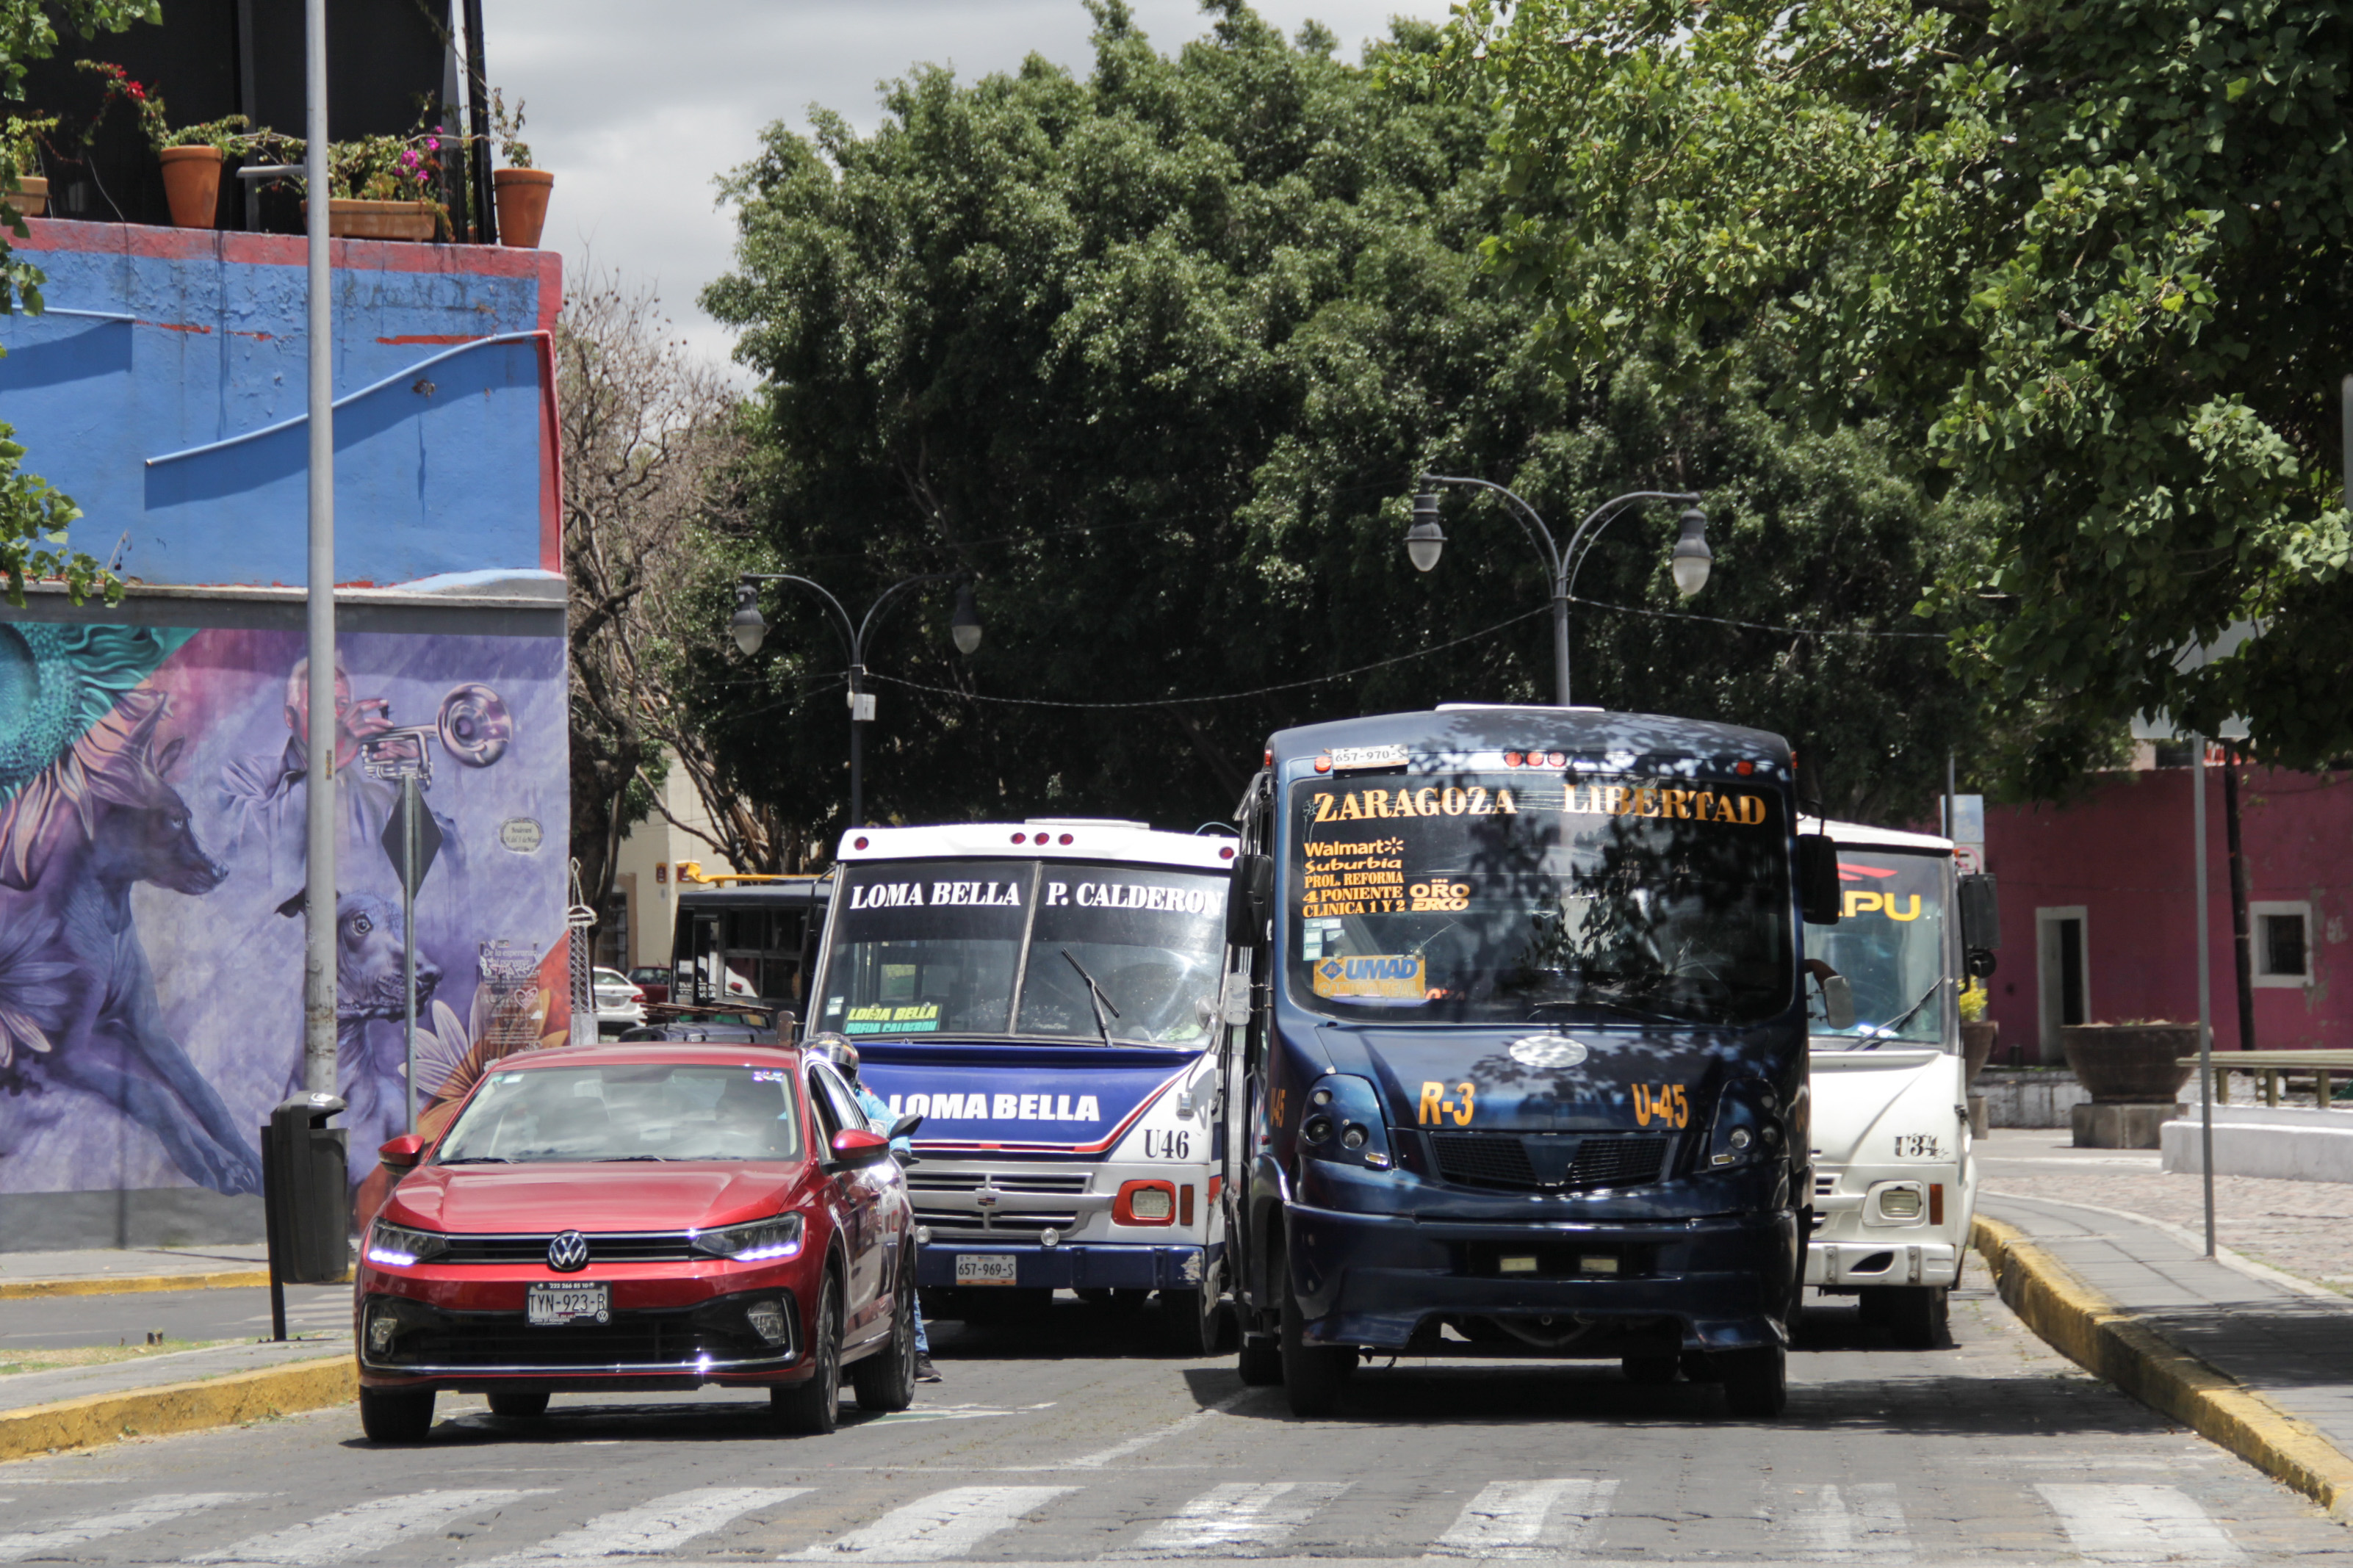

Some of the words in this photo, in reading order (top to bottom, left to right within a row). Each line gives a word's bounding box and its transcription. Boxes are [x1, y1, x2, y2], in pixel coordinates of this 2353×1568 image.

[1314, 787, 1518, 823] ZARAGOZA
[1563, 783, 1766, 825] LIBERTAD
[1304, 839, 1385, 858] Walmart
[1304, 856, 1402, 875] Suburbia
[1304, 874, 1341, 889] PROL.
[1344, 871, 1404, 886] REFORMA
[849, 883, 924, 909] LOMA
[929, 882, 1020, 906] BELLA
[1045, 882, 1069, 906] P.
[1076, 883, 1224, 916] CALDERON
[1302, 889, 1318, 903] 4
[1320, 886, 1403, 902] PONIENTE
[1409, 883, 1470, 898] ORO
[1302, 901, 1365, 917] CLINICA
[1369, 902, 1377, 913] 1
[1381, 900, 1393, 912] Y
[1396, 900, 1405, 911] 2
[1410, 897, 1469, 911] ERCO
[1838, 890, 1921, 922] PU
[1344, 957, 1419, 980] UMAD
[1380, 980, 1420, 998] REAL
[847, 1008, 892, 1021] LOMA
[893, 1005, 938, 1021] BELLA
[889, 1094, 988, 1120] LOMA
[992, 1094, 1100, 1121] BELLA
[1419, 1081, 1475, 1126] R-3
[1631, 1083, 1688, 1129] U-45
[1144, 1129, 1189, 1159] U46
[1895, 1135, 1939, 1157] U34
[958, 1263, 1014, 1276] 657-969-S
[529, 1293, 605, 1312] TYN-923-B
